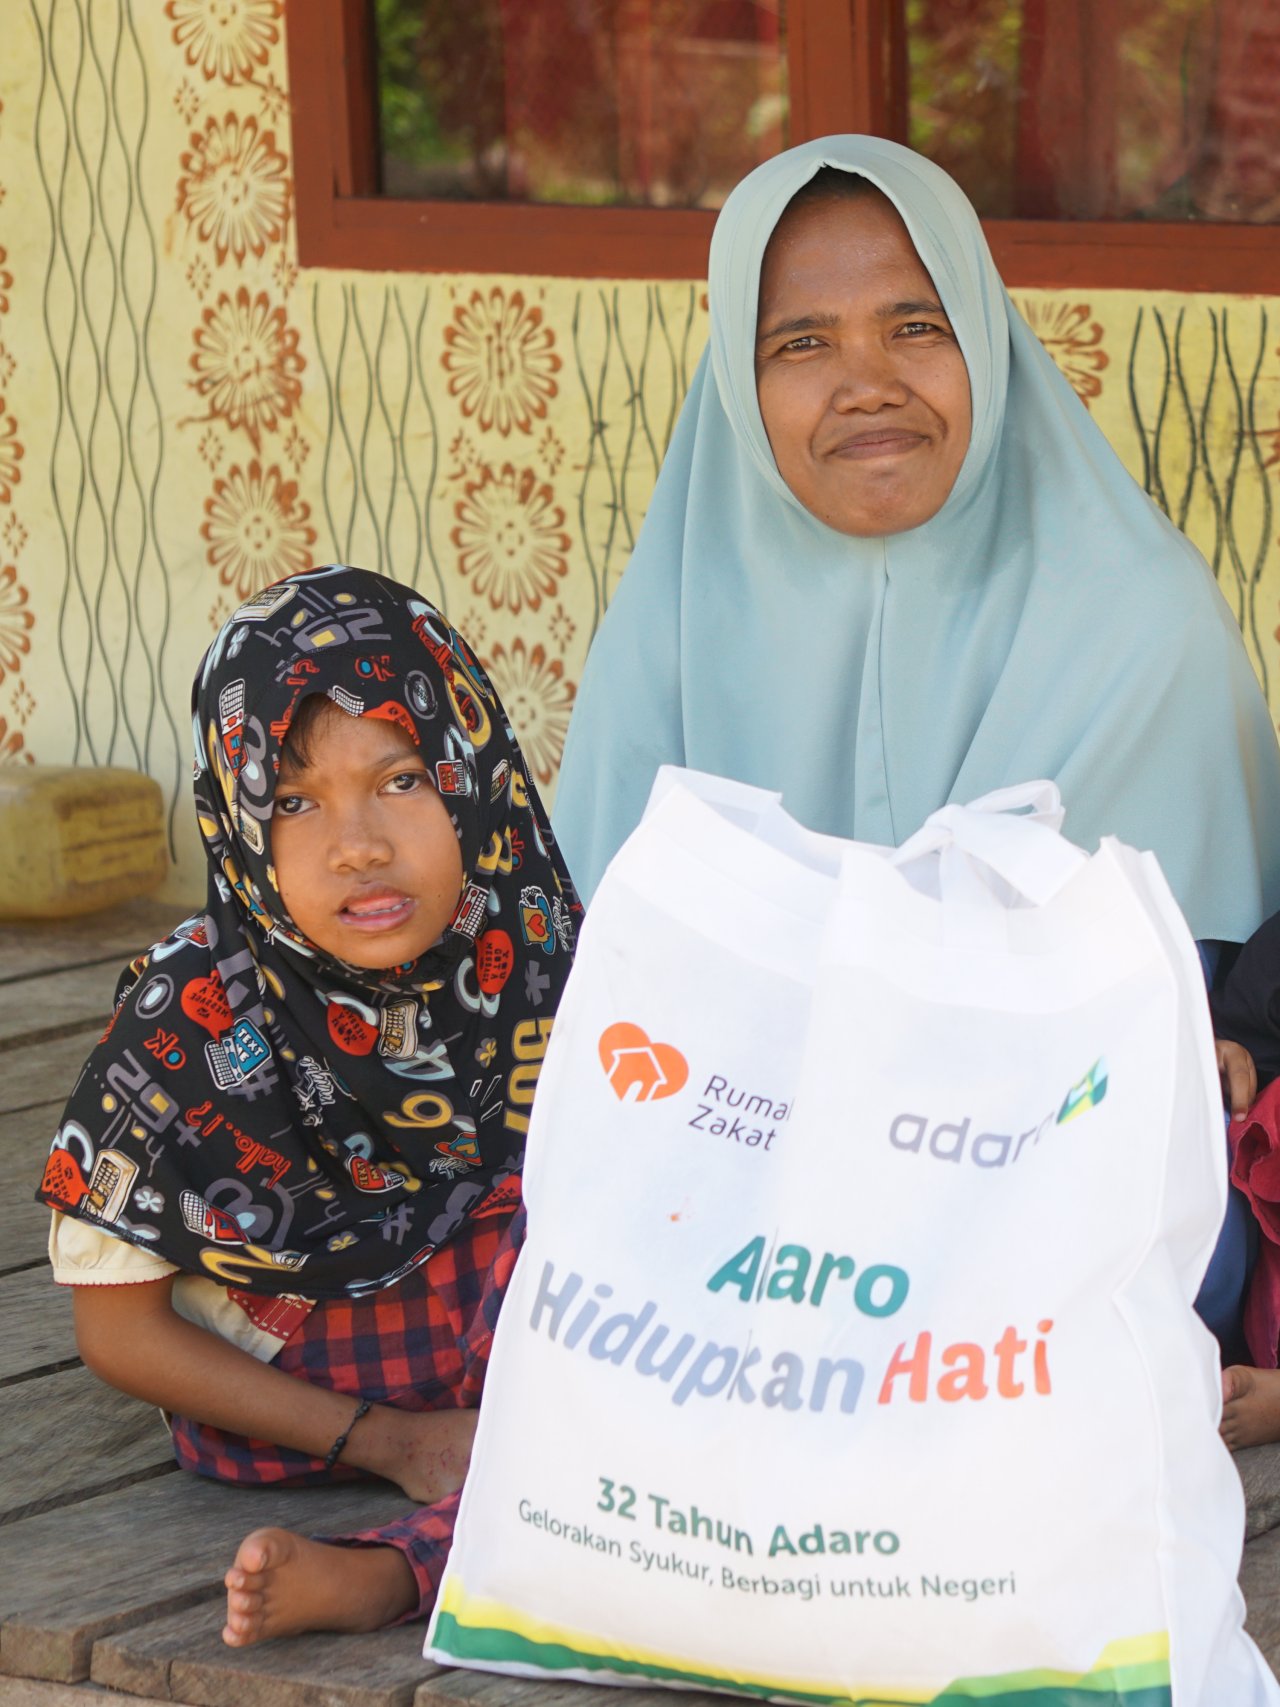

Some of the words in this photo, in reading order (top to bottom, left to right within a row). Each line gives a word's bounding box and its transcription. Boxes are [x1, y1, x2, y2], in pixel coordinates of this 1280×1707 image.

[237, 1028, 265, 1057] TEXT
[688, 1104, 777, 1151] Zakat
[703, 1075, 796, 1122] Ruma
[706, 1228, 910, 1318] Aaro
[528, 1260, 866, 1415] Hidupkan
[877, 1318, 1055, 1405] Hati
[518, 1498, 622, 1558] Gelorakan
[629, 1541, 714, 1588] Syukur,
[721, 1565, 821, 1601] Berbagi
[829, 1575, 910, 1599] untuk
[921, 1571, 1016, 1601] Negeri
[597, 1476, 637, 1521] 32
[647, 1493, 754, 1556] Tahun
[767, 1523, 901, 1557] Adaro
